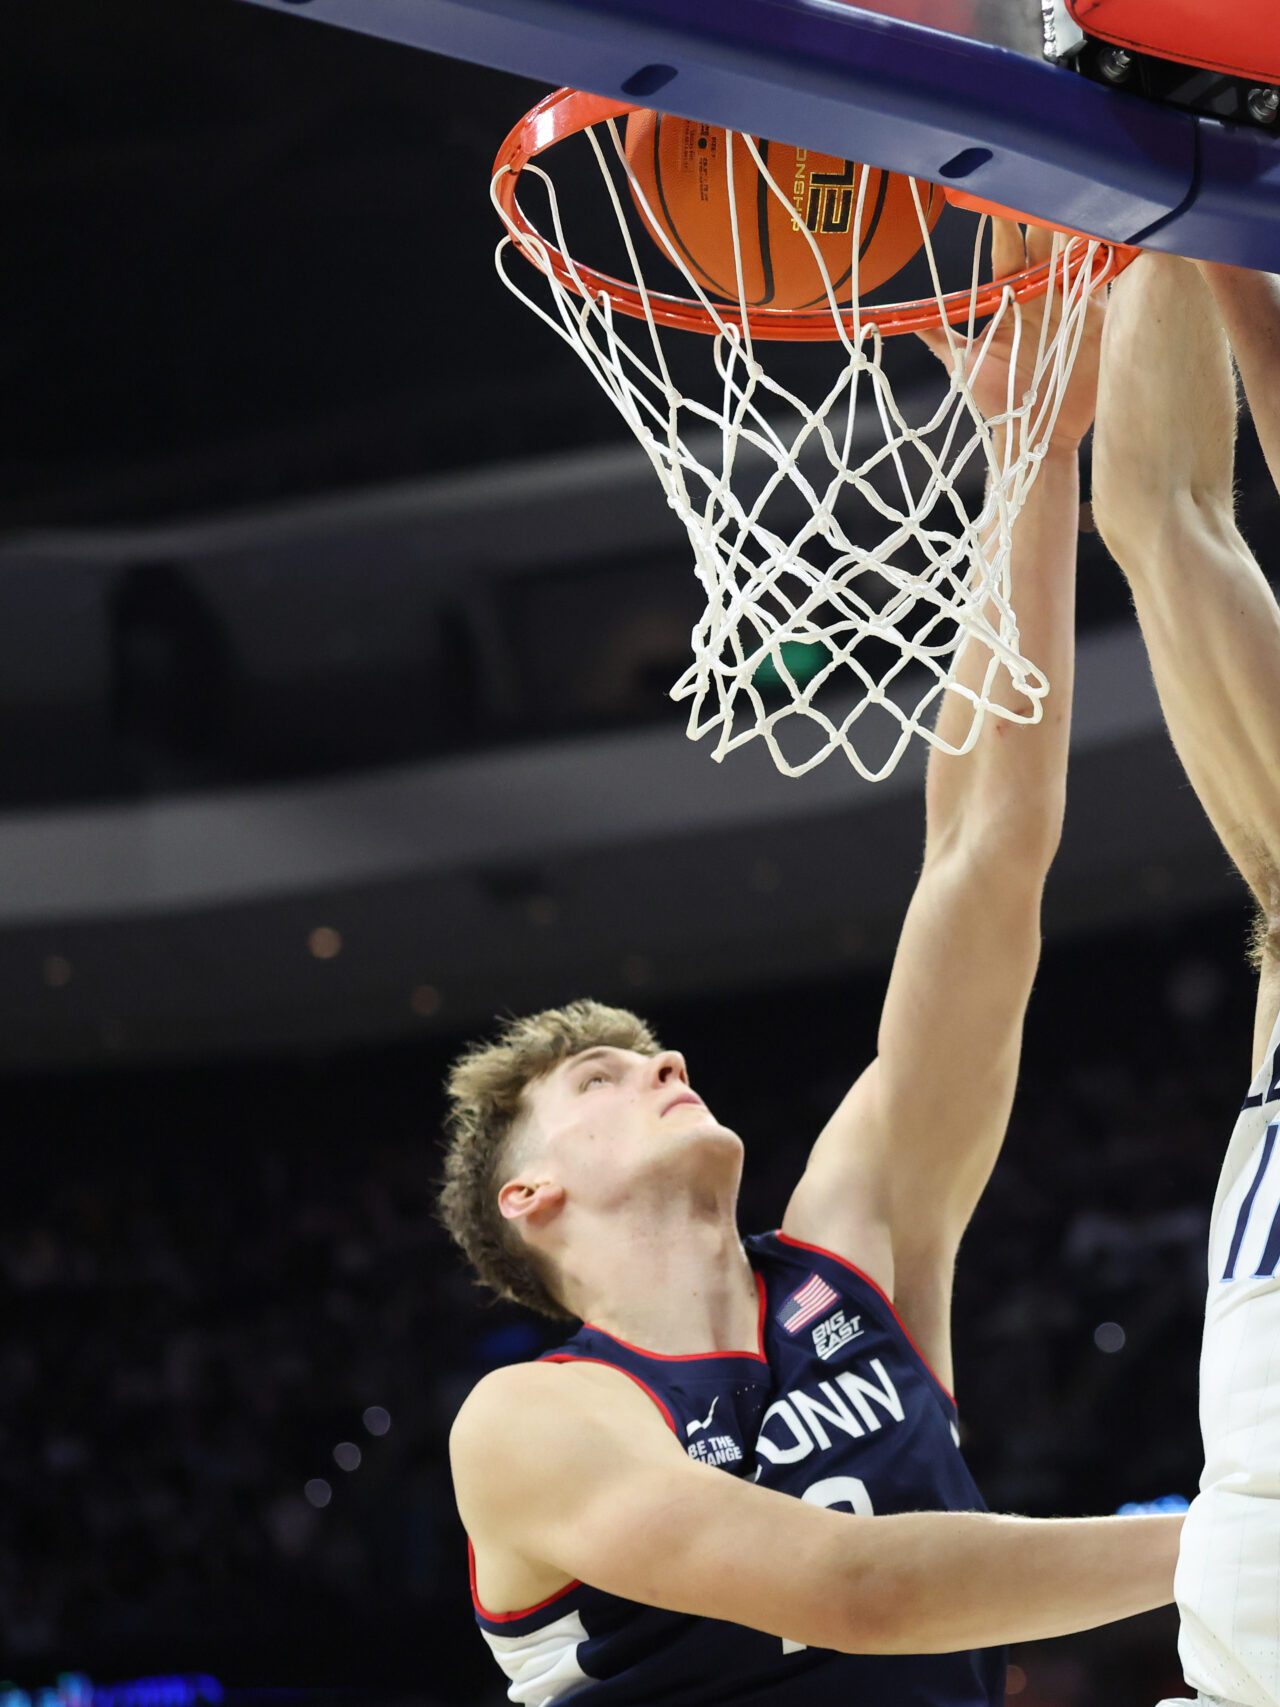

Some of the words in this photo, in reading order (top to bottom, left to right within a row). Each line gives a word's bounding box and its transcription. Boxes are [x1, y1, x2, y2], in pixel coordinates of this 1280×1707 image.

[791, 147, 808, 232] ONSHP
[812, 1309, 846, 1345] BIG
[815, 1315, 862, 1358] EAST
[755, 1357, 906, 1470] ONN
[688, 1440, 708, 1459] BE
[708, 1435, 736, 1451] THE
